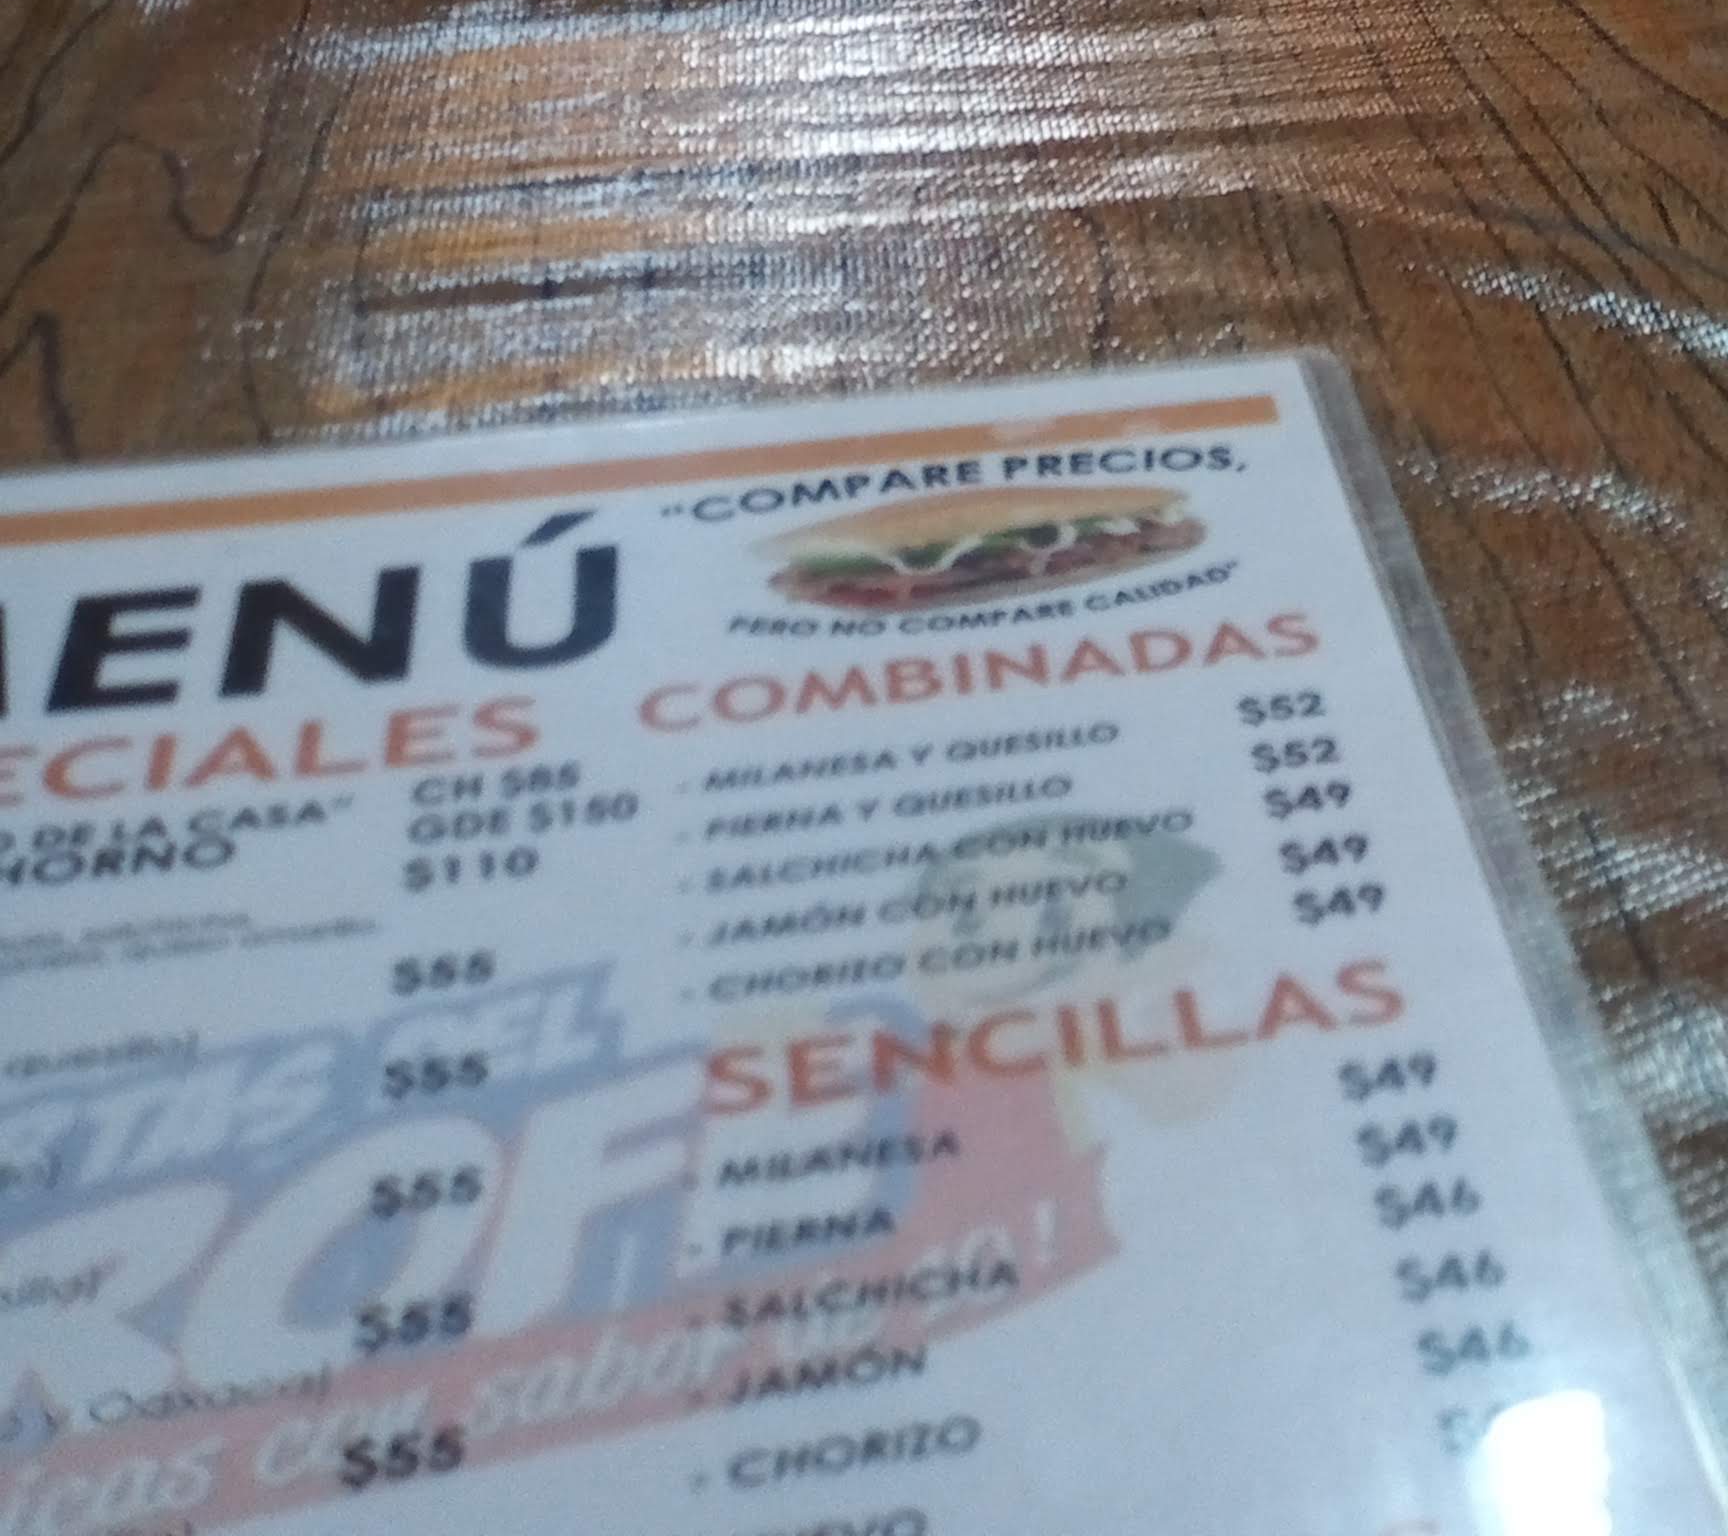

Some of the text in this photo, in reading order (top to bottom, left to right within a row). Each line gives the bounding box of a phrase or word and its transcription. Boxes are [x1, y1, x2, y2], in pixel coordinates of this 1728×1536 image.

[1002, 445, 1248, 482] PRECIOS,
[0, 508, 621, 718] ENÚ
[829, 614, 887, 637] NO
[897, 598, 1075, 635] COMPARE
[637, 612, 1322, 735] COMBINADAS
[410, 772, 484, 806] CH
[704, 748, 898, 792] MILANESA
[910, 743, 934, 766] Y
[1236, 688, 1328, 728] $52
[856, 799, 880, 822] Y
[1250, 735, 1341, 775] $52
[402, 844, 540, 893] $110
[705, 780, 1352, 893] SALCHICHA CON HUEVO $49
[876, 892, 978, 925] CON
[990, 870, 1128, 909] HUEVO
[1278, 833, 1369, 876] $49
[917, 938, 1019, 976] CON
[1292, 881, 1386, 928] $49
[702, 959, 1406, 1117] SENCILLAS
[716, 1049, 1438, 1188] MILANESA $49
[720, 1110, 1459, 1257] PIERNA $49
[721, 1258, 1020, 1329] SALCHICHA
[1373, 1174, 1484, 1230] $46
[729, 1245, 1508, 1406] JAMÓN $46
[725, 1318, 1532, 1491] CHORIZO $46
